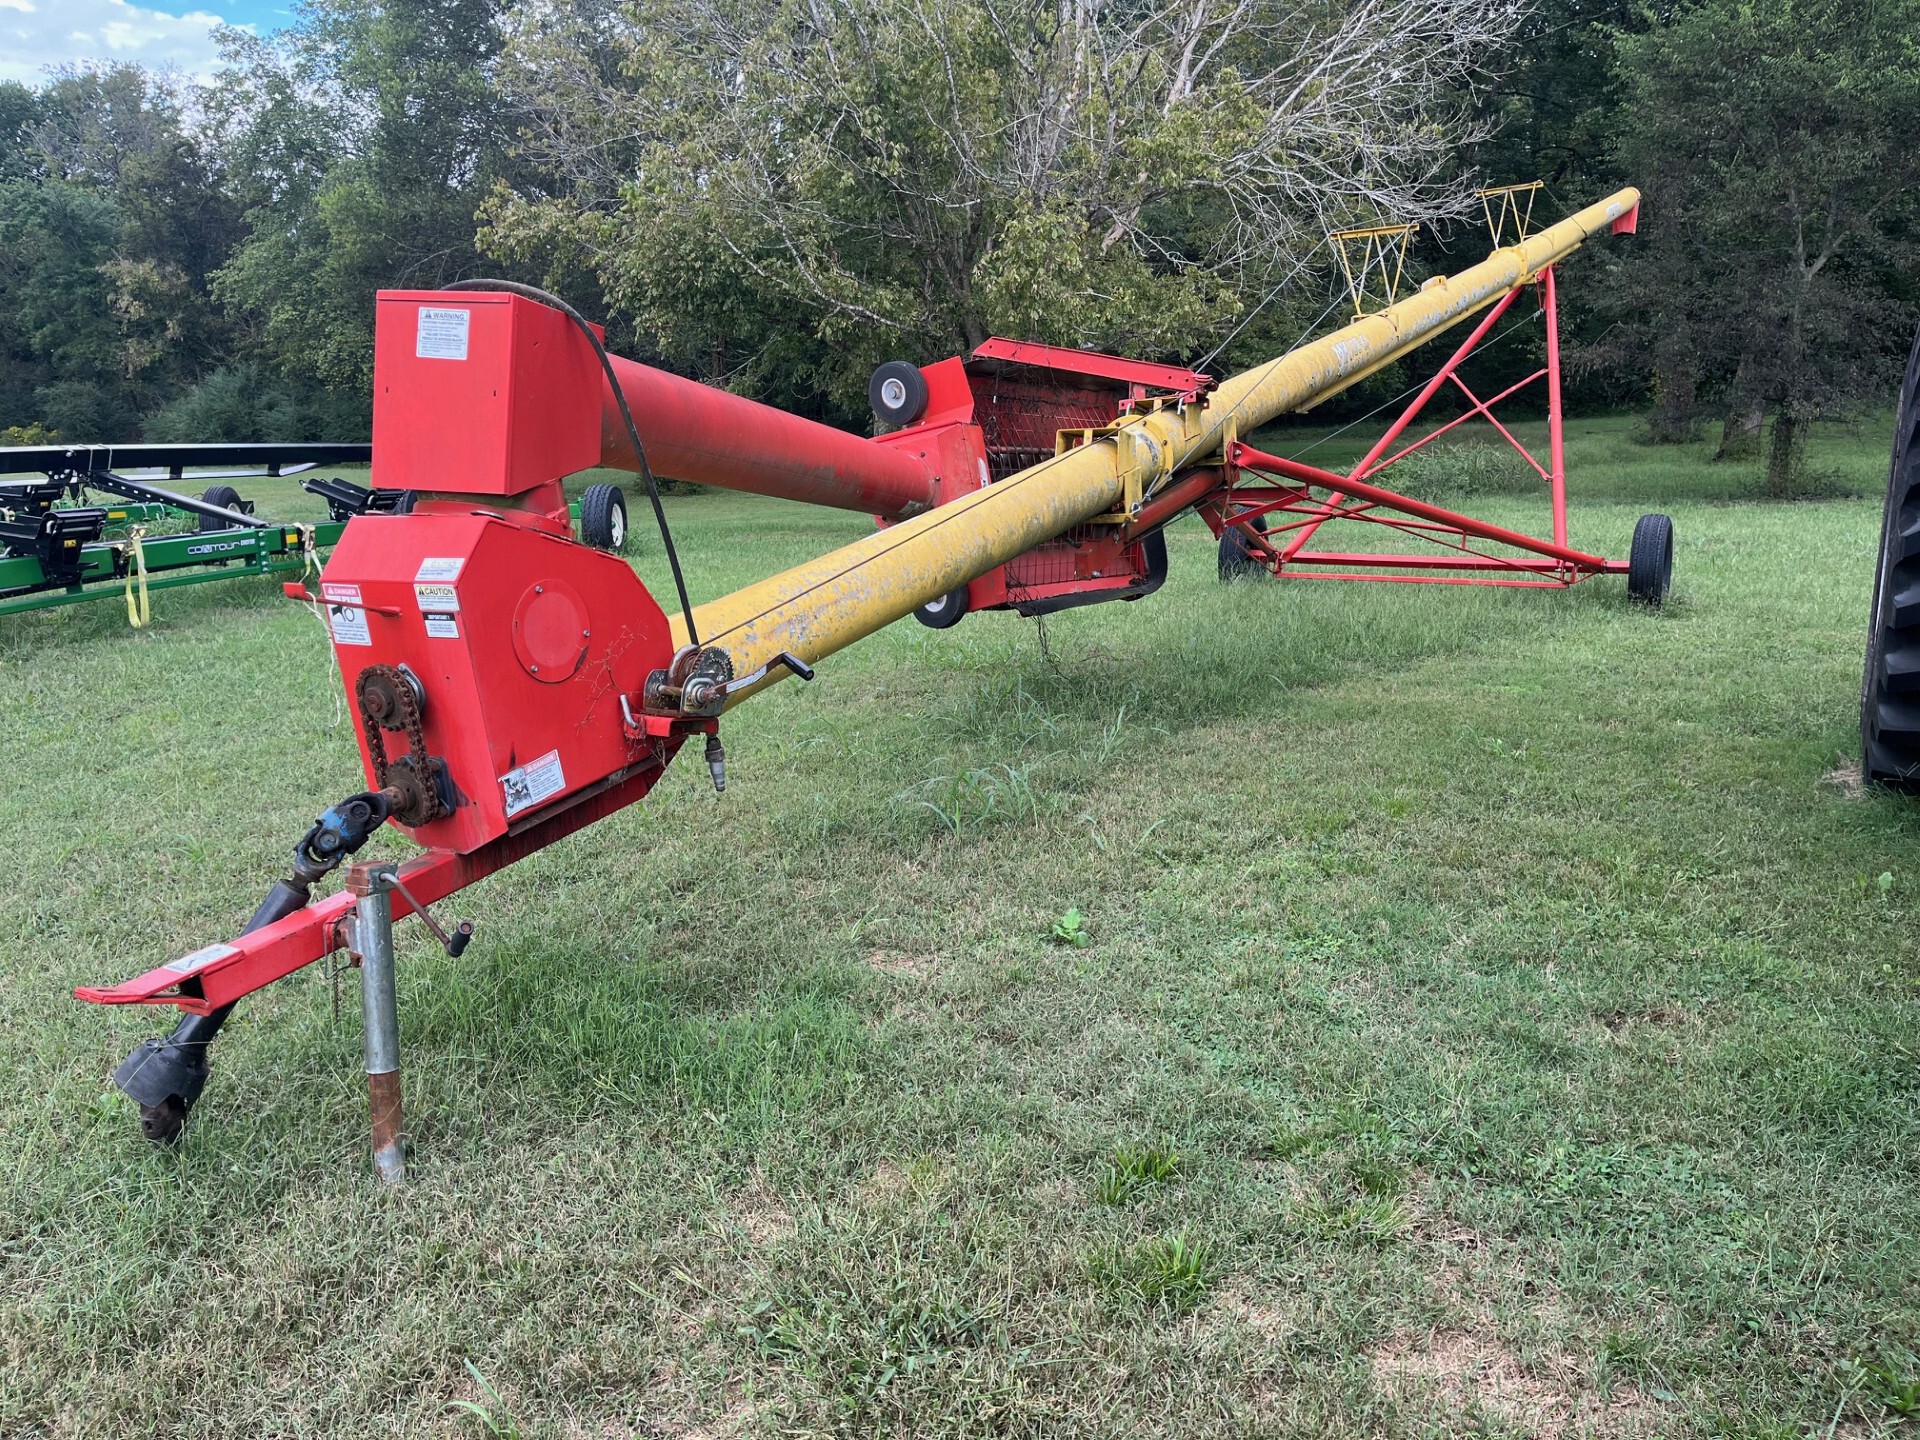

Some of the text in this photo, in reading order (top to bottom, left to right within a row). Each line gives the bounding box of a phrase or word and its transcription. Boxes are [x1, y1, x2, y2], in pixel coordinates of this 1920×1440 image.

[433, 312, 464, 320] WARNING
[333, 587, 357, 596] DANGER
[424, 587, 453, 596] CAUTION
[532, 755, 555, 770] DANGER
